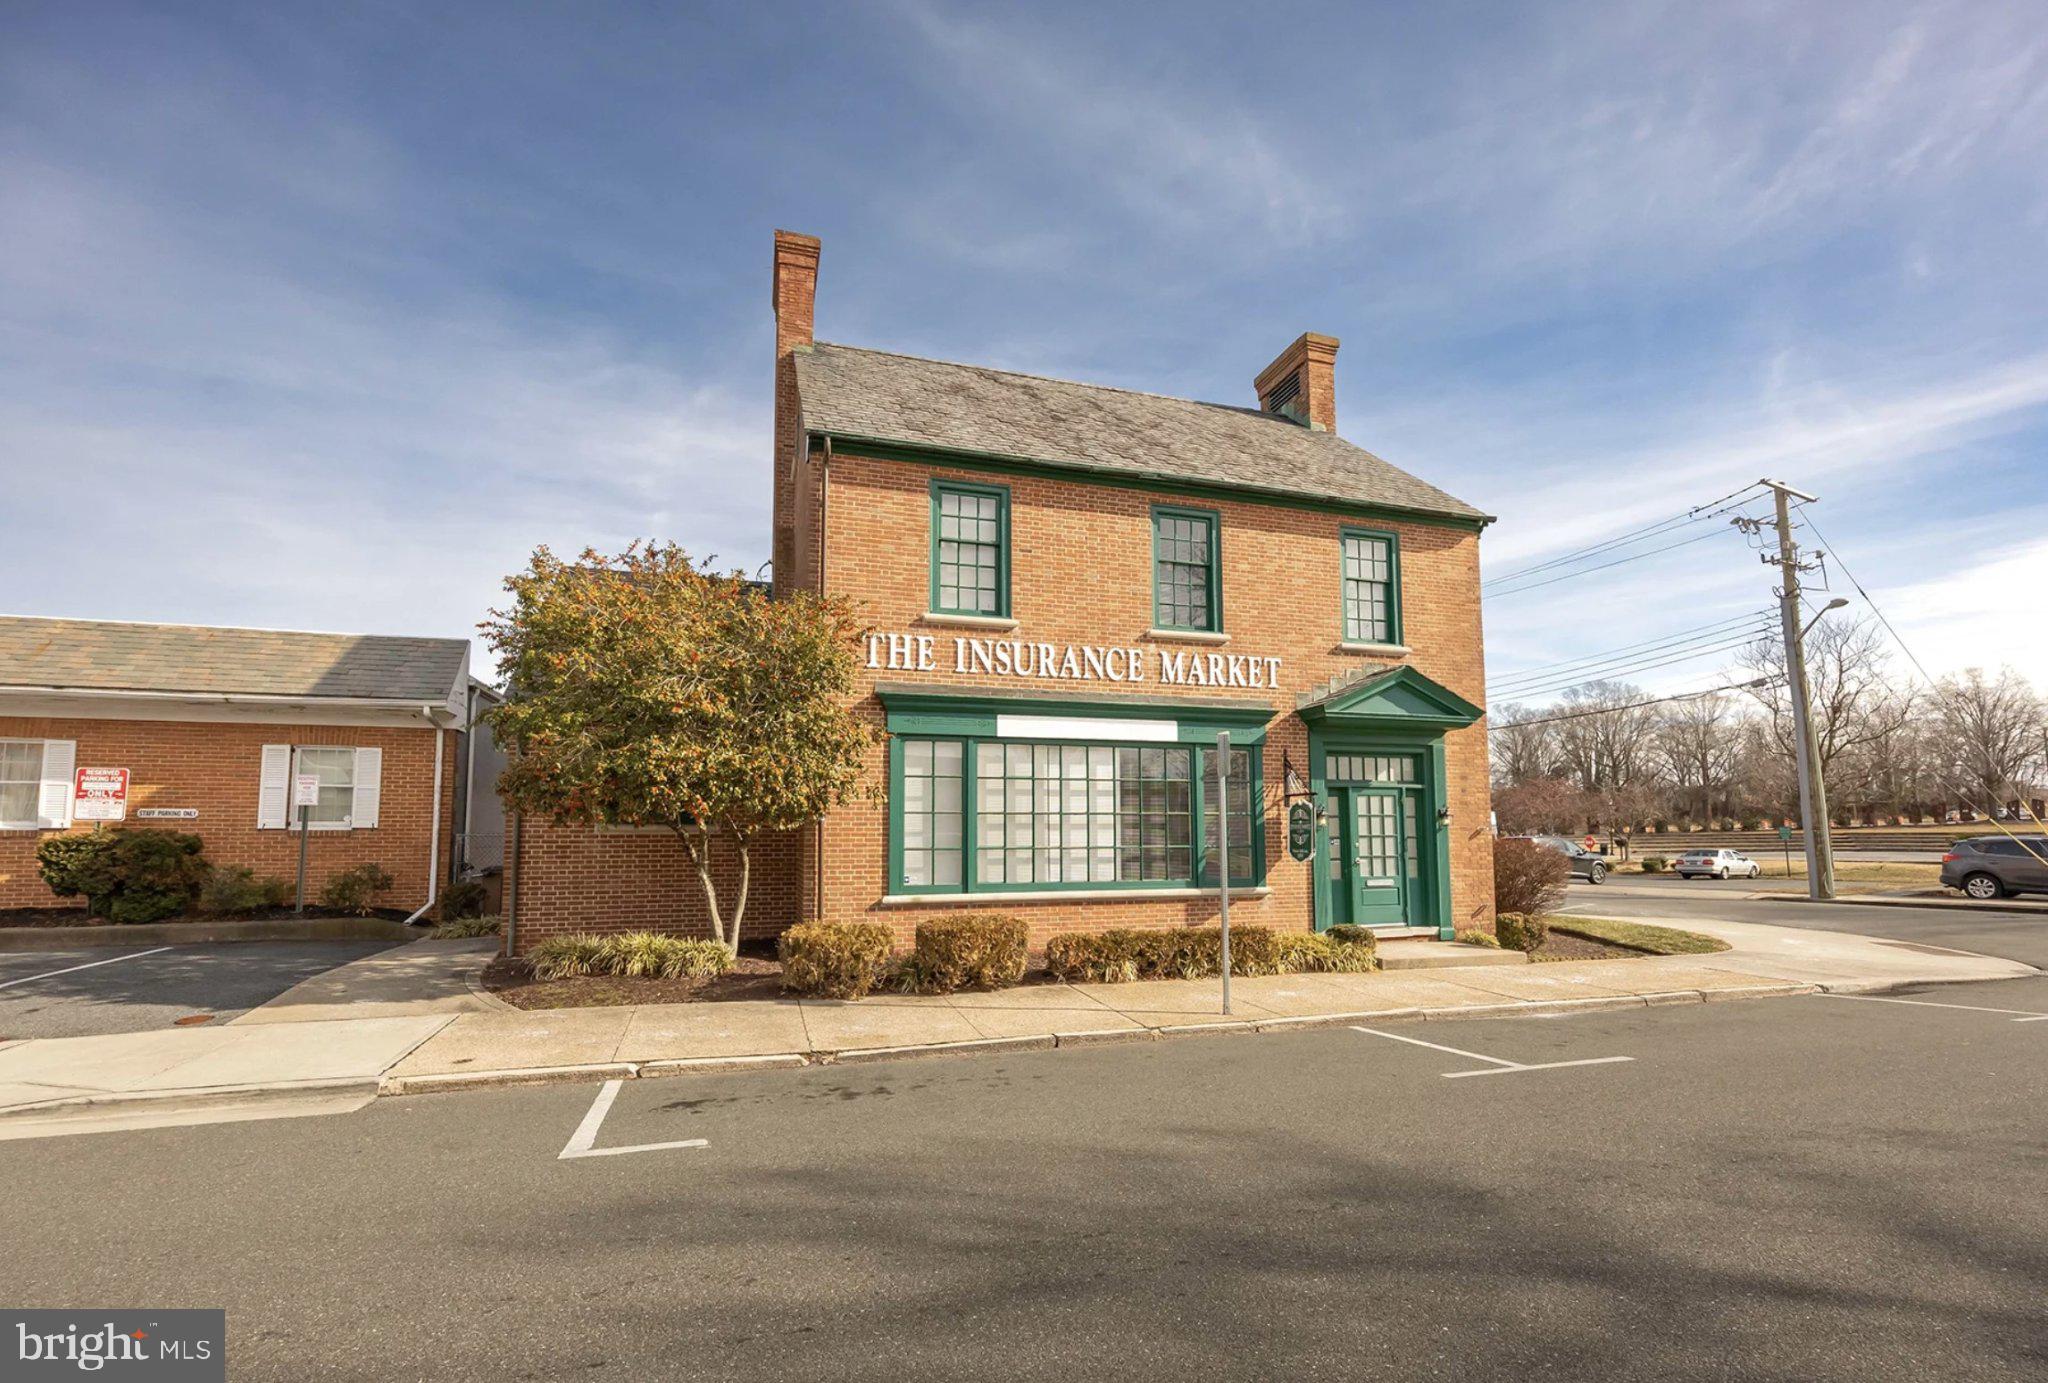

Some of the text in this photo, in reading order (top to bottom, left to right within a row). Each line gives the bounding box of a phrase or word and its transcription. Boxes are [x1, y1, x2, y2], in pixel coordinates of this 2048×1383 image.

[864, 632, 1281, 688] THE INSURANCE MARKET
[87, 790, 114, 798] ONLY
